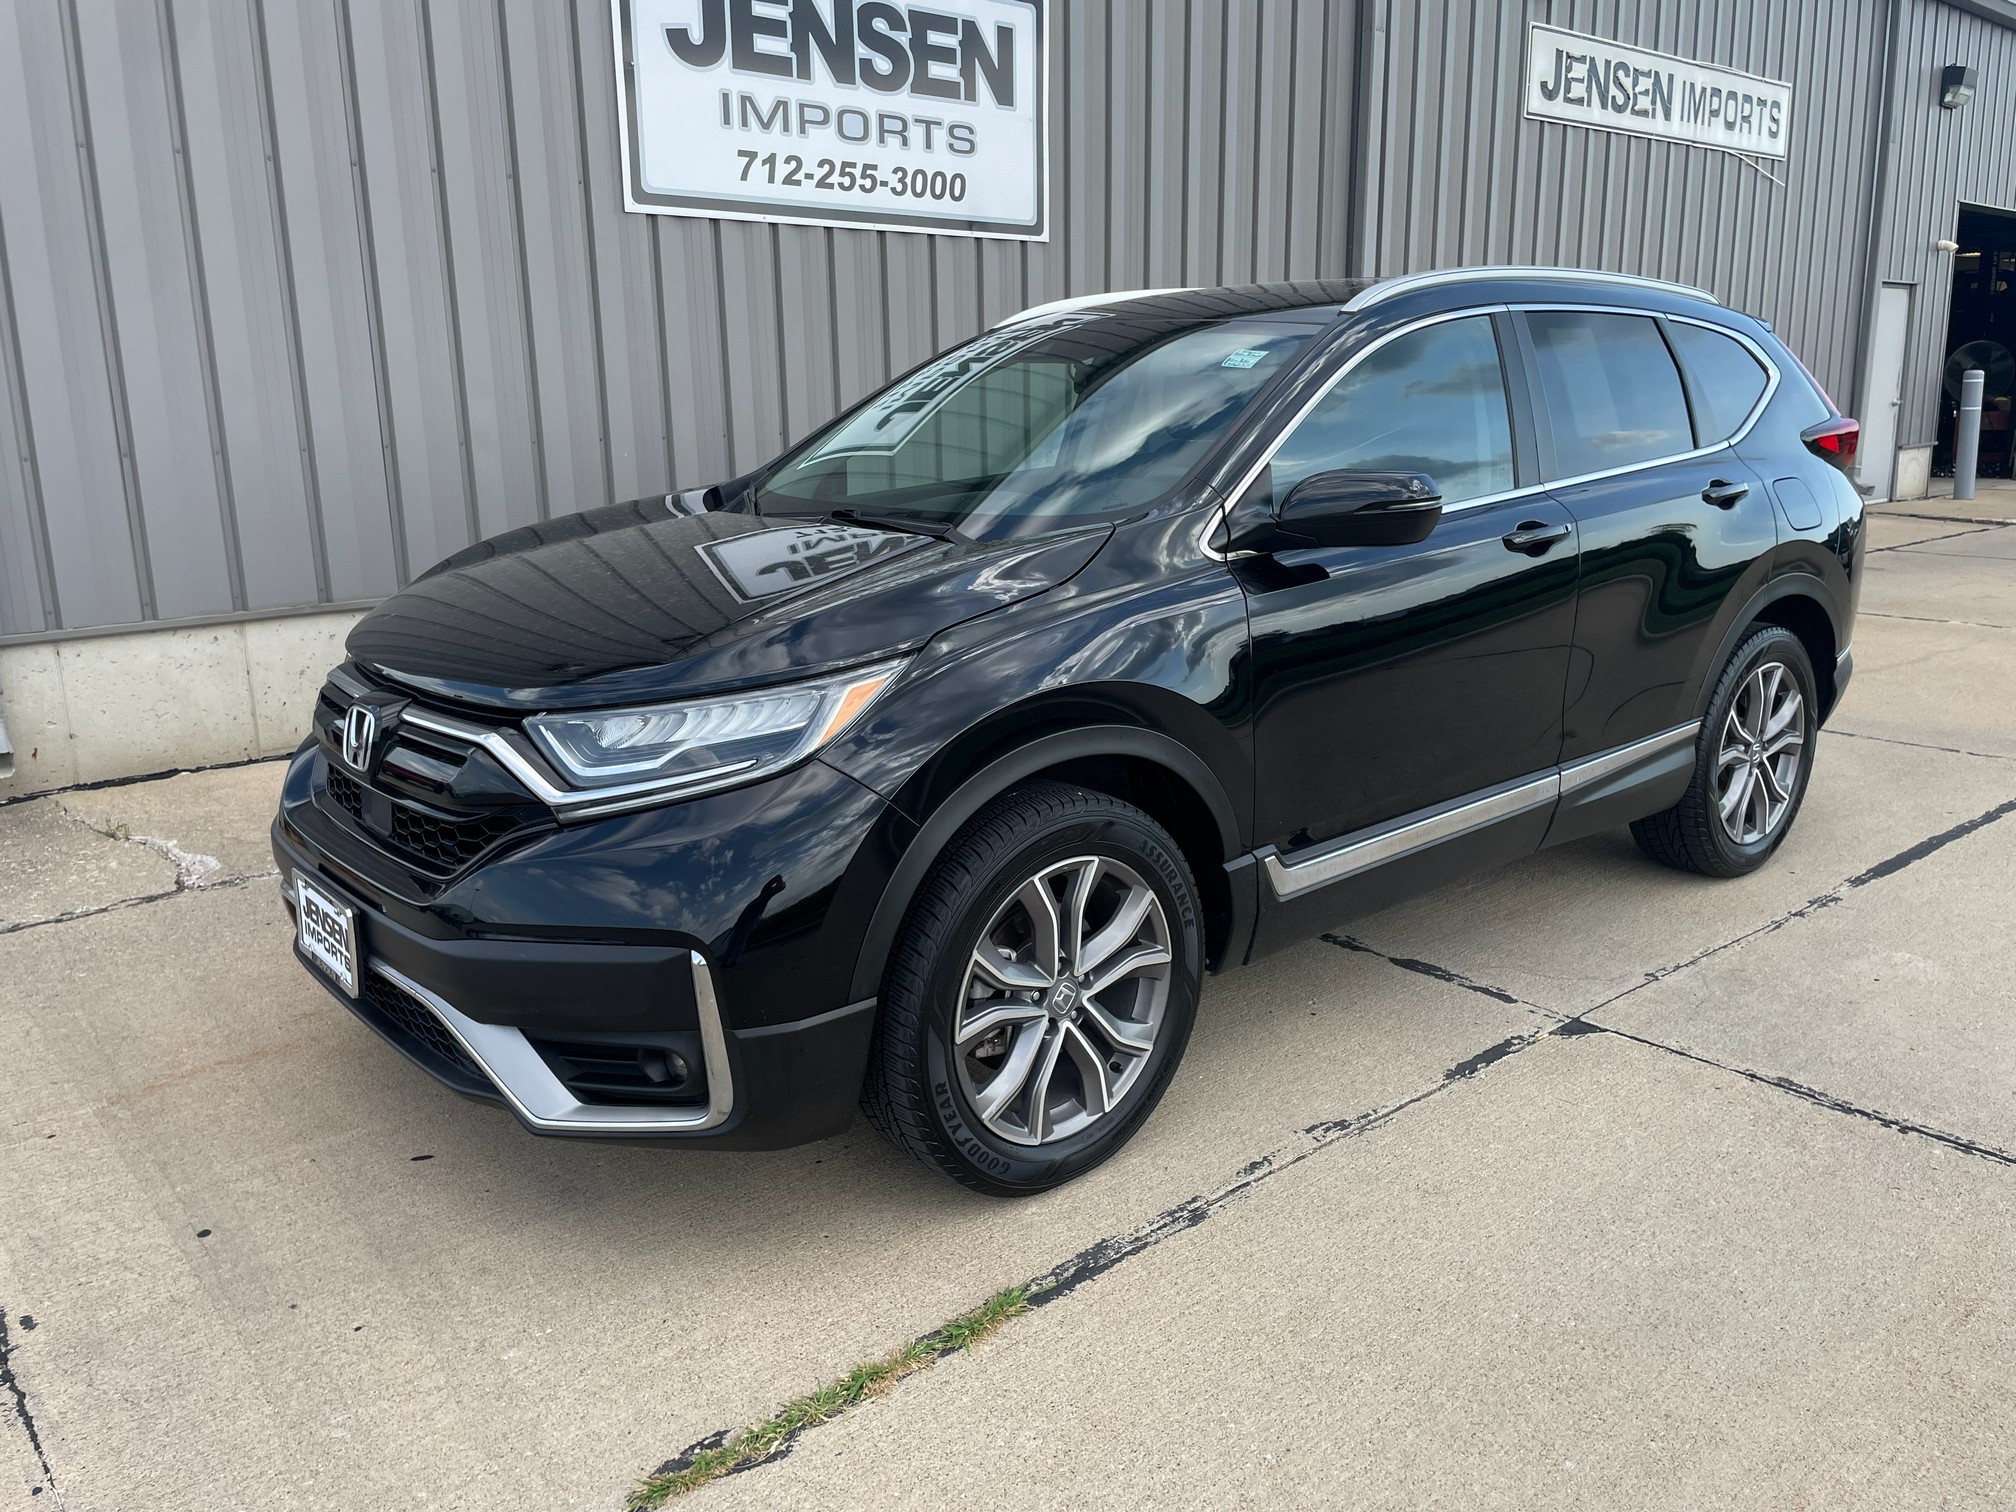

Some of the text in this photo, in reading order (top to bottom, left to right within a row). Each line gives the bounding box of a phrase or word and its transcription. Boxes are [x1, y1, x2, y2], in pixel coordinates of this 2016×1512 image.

[663, 0, 1016, 108] JENSEN
[721, 92, 976, 155] IMPORTS
[1540, 48, 1781, 139] JENSEN IMPORTS
[736, 149, 967, 202] 712-255-3000
[1136, 840, 1195, 929] ASSURANCE
[303, 895, 349, 953] JENSEN
[304, 919, 351, 972] IMPORTS
[934, 1081, 1012, 1175] GOODYEAR
